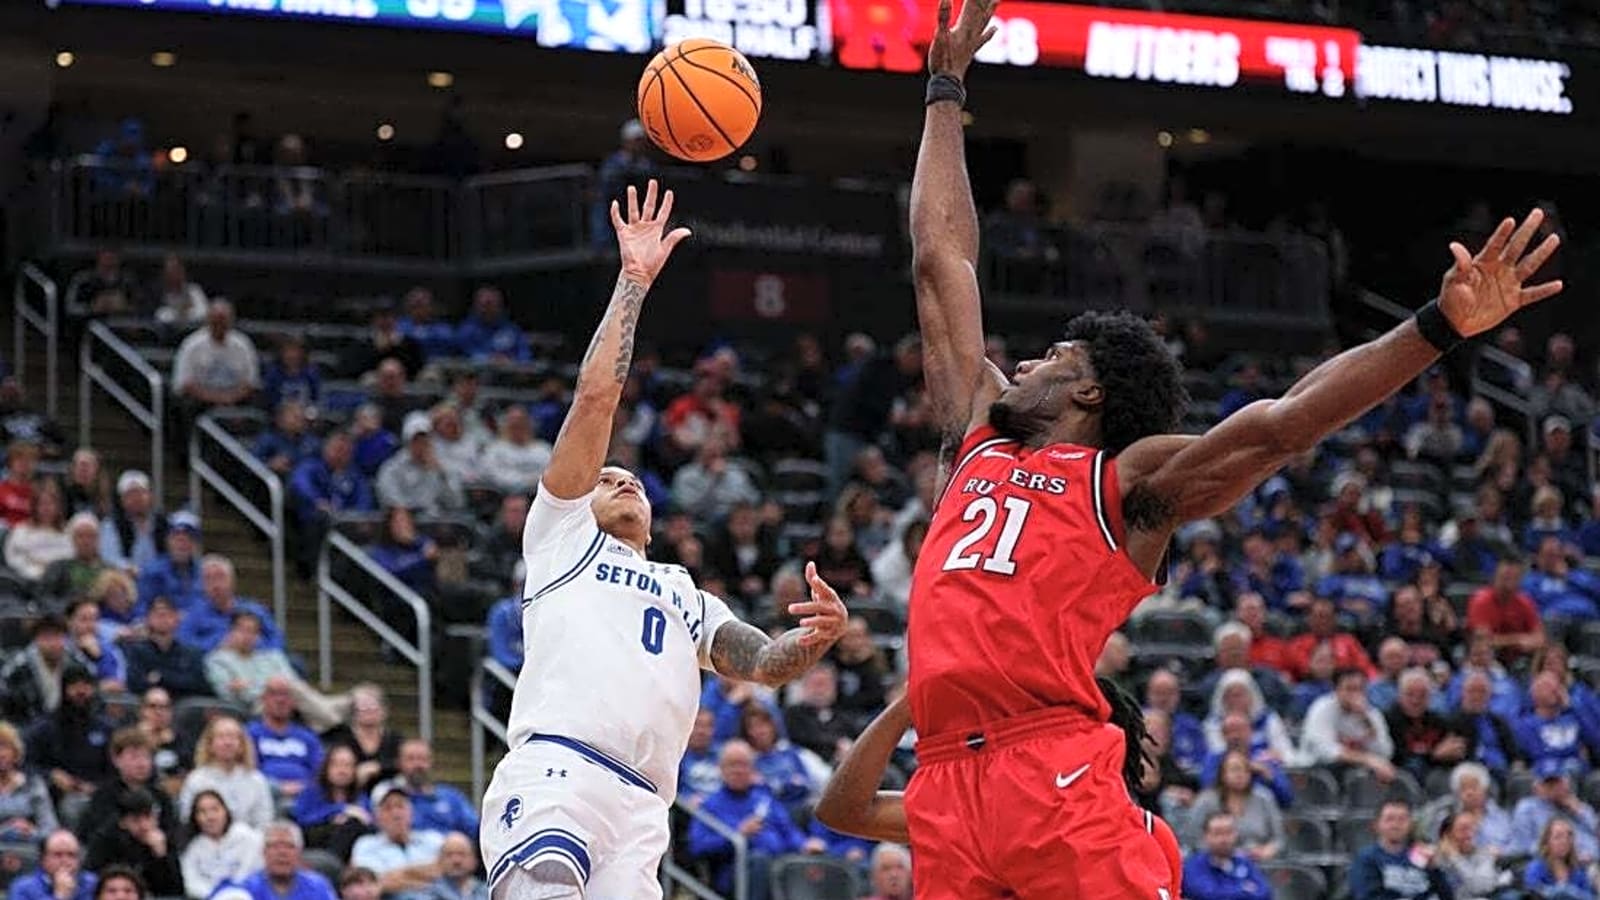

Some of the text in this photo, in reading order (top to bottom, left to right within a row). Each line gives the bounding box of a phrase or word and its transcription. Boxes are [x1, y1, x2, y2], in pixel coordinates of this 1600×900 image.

[754, 274, 785, 318] 8
[962, 467, 1068, 495] RUERS
[941, 495, 1033, 577] 21
[595, 562, 662, 597] SETON
[641, 606, 667, 656] 0
